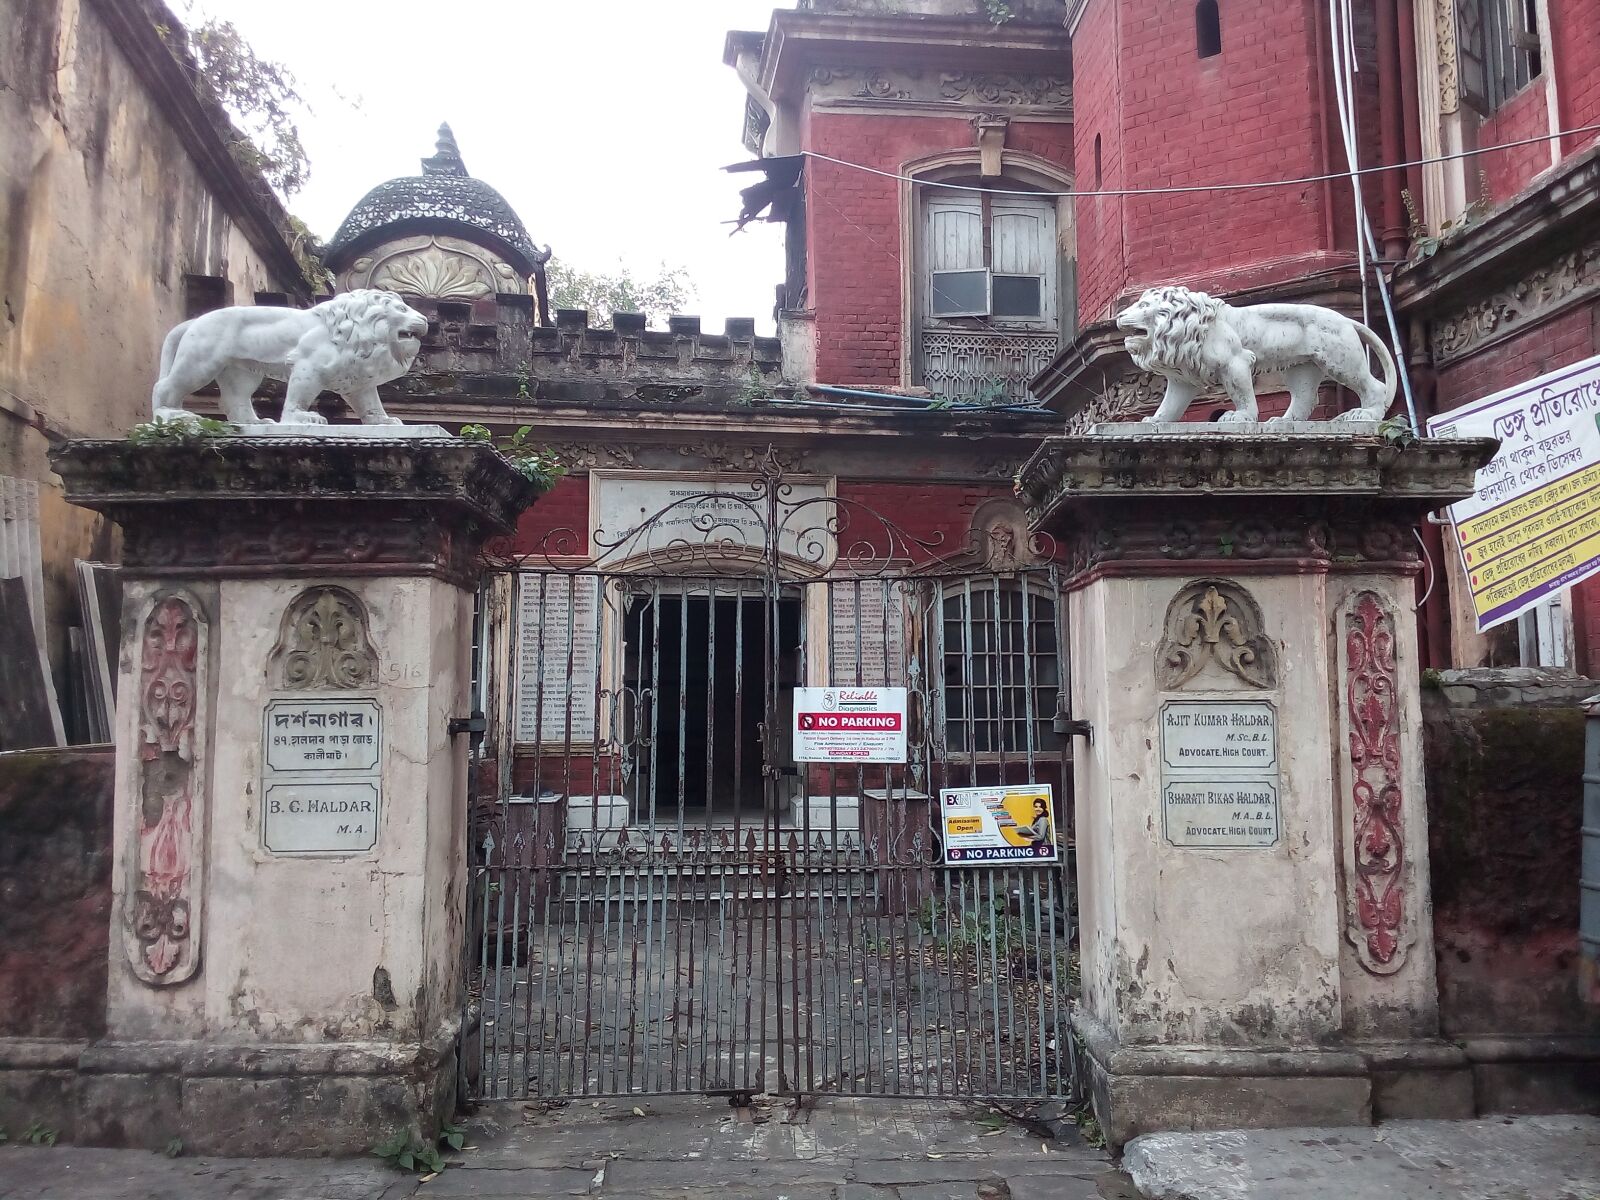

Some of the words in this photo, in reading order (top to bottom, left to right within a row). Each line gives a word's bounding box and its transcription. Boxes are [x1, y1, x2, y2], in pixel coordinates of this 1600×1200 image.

[1493, 409, 1533, 443] ডেঙ্গু
[1509, 443, 1536, 465] থাকুন
[1536, 429, 1573, 452] বছরভর
[1519, 464, 1546, 485] থেকে
[1546, 447, 1583, 474] ডিসেম্বর
[838, 690, 878, 701] Reliable
[818, 717, 838, 727] NO
[841, 717, 896, 727] PARKING
[1194, 713, 1228, 727] KUMAR
[1222, 747, 1240, 757] HIGH
[1168, 791, 1206, 805] BHARATI
[1208, 791, 1234, 805] BIKAS
[270, 800, 285, 814] B.
[1228, 826, 1247, 836] HIGH
[966, 850, 983, 859] NO
[986, 848, 1034, 858] PARKING
